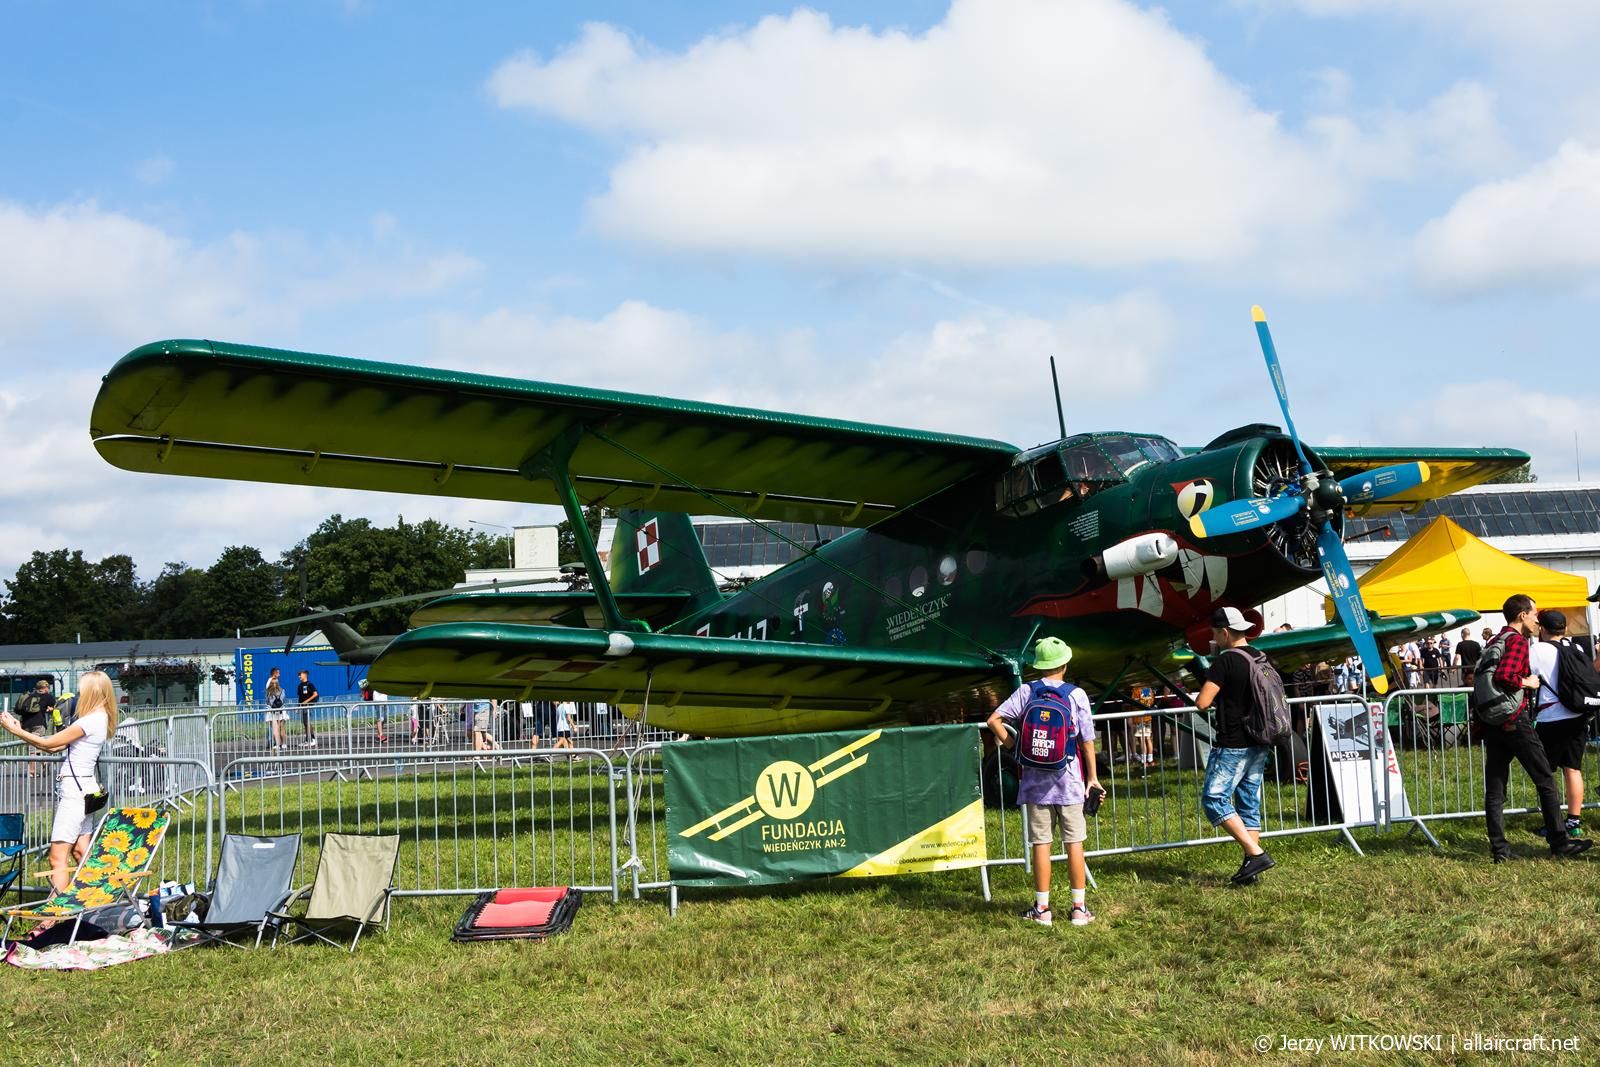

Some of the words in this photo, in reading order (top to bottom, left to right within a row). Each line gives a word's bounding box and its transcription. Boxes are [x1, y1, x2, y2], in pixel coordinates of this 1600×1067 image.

[1032, 728, 1048, 739] FCB
[1031, 747, 1049, 757] 1899
[766, 771, 801, 808] W
[761, 819, 845, 841] FUNDACJA
[763, 839, 822, 853] WIEDEŃCZYK
[824, 838, 846, 849] AN-2
